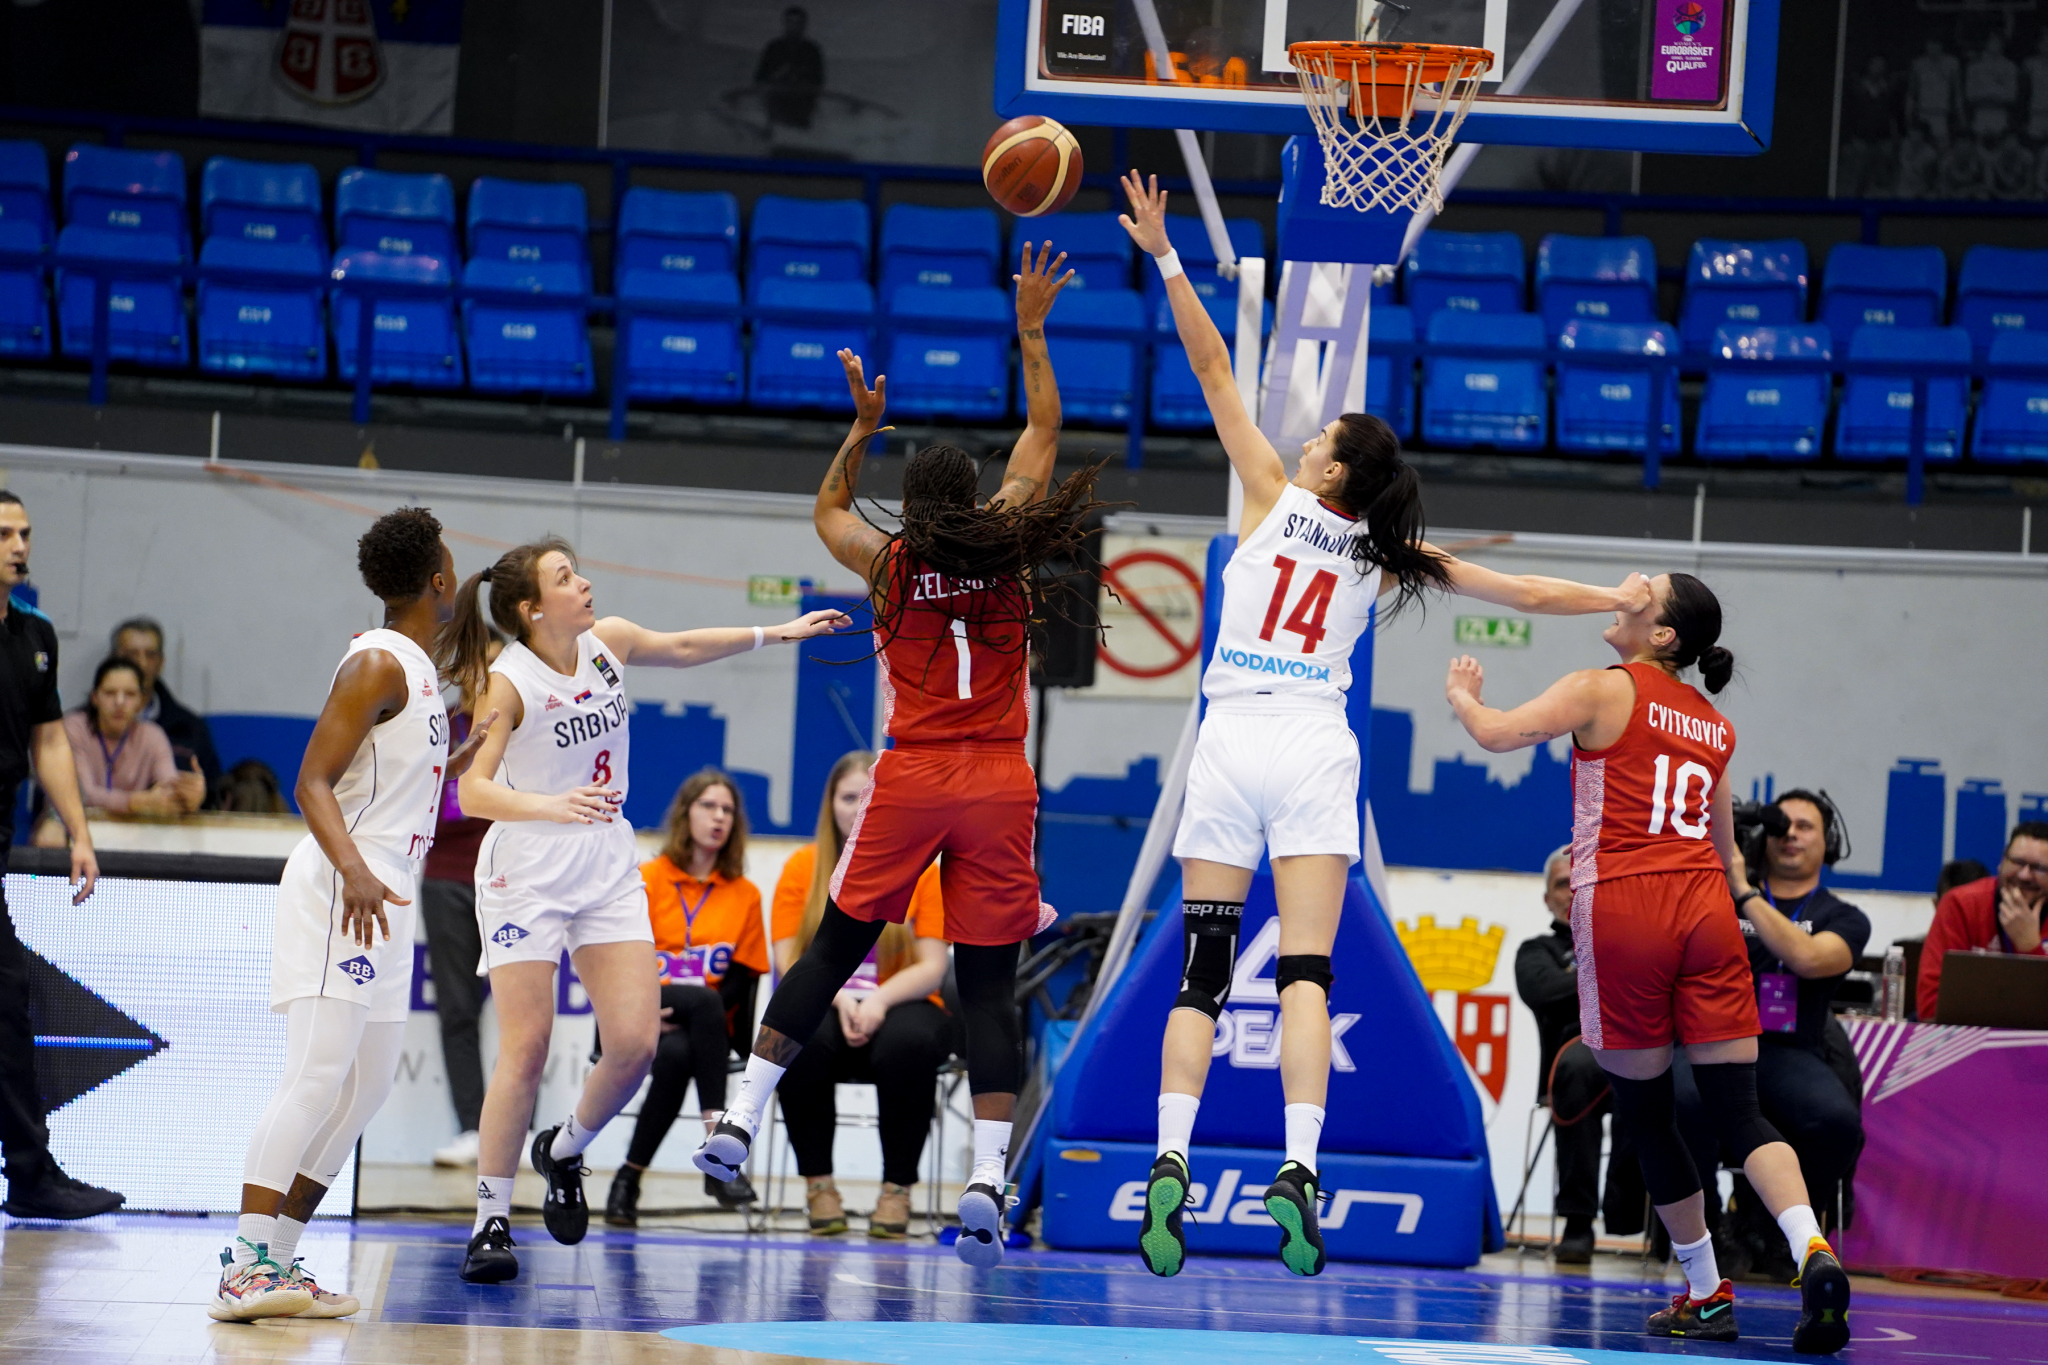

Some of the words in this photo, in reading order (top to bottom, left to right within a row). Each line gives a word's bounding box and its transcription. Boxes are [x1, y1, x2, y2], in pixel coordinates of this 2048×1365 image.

[1061, 14, 1105, 36] FIBA
[1056, 51, 1067, 59] We
[1068, 52, 1077, 60] Are
[1661, 45, 1714, 56] EUROBASKET
[1284, 513, 1359, 562] STANKOVI
[1259, 554, 1338, 654] 14
[1458, 618, 1529, 643] IZLAZ
[950, 617, 972, 700] 1
[1219, 646, 1330, 683] VODAVODA
[554, 693, 628, 748] SRBIJA
[1648, 702, 1727, 751] CVITKOVIĆ
[592, 749, 612, 785] 8
[430, 766, 441, 813] 7
[1648, 754, 1713, 840] 10
[498, 928, 520, 941] RB
[349, 961, 371, 977] RB
